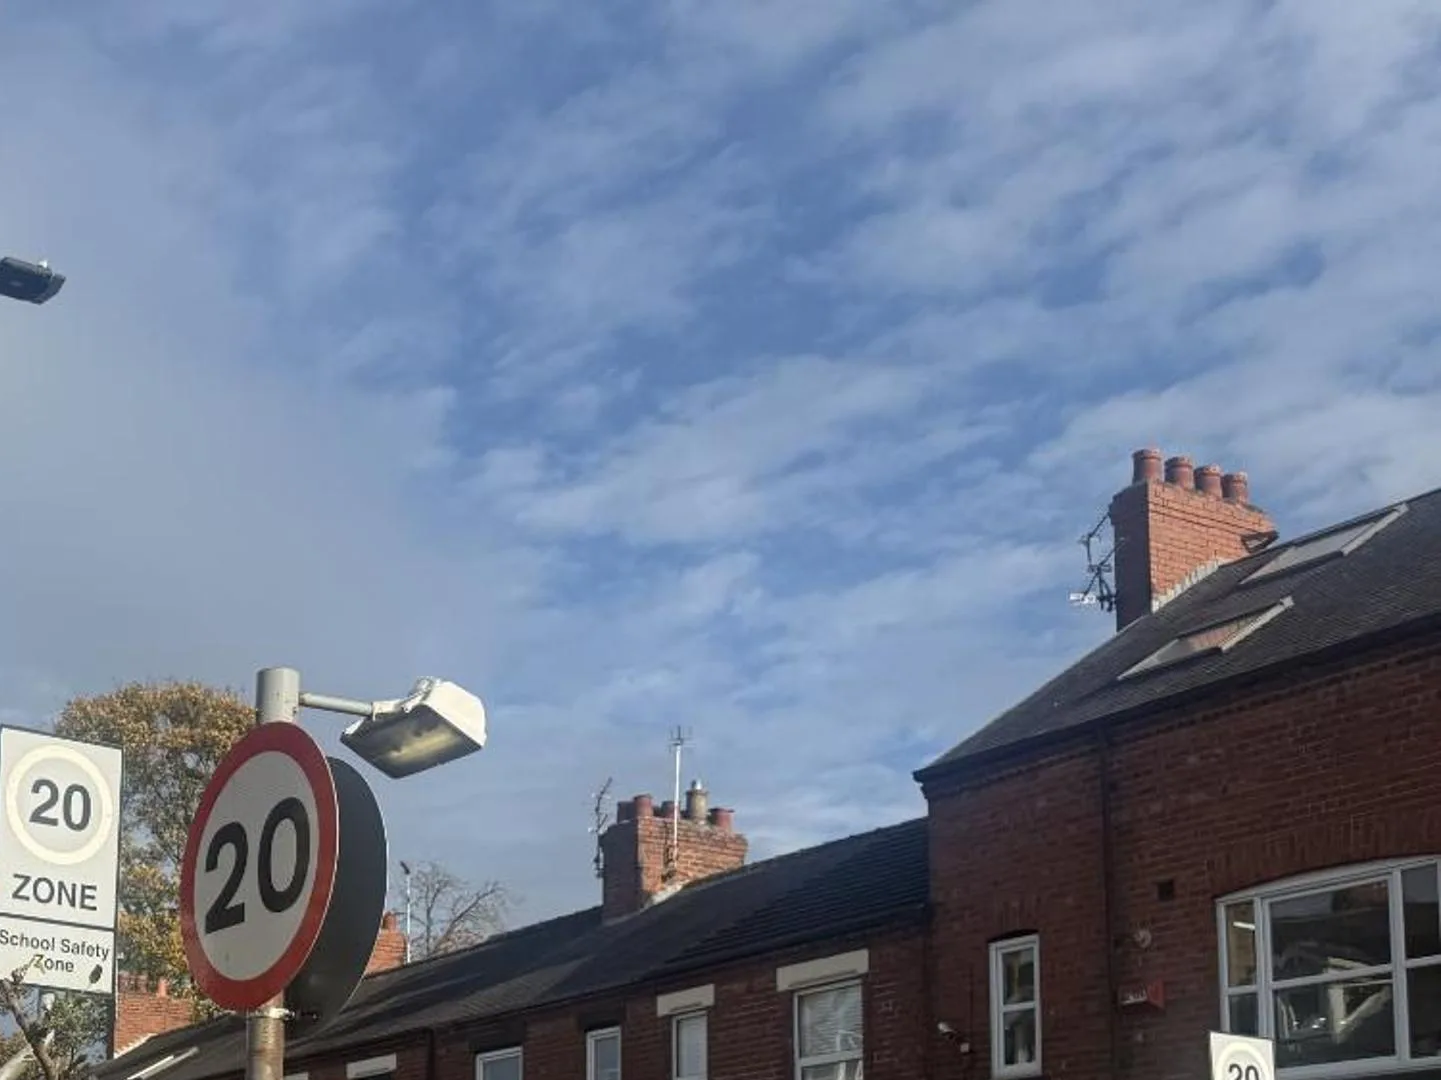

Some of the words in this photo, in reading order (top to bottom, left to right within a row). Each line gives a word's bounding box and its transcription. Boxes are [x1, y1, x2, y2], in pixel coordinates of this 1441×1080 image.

[29, 778, 91, 831] 20
[205, 797, 310, 934] 20
[11, 873, 98, 911] ZONE
[33, 953, 75, 974] Zone
[60, 938, 110, 962] Safety
